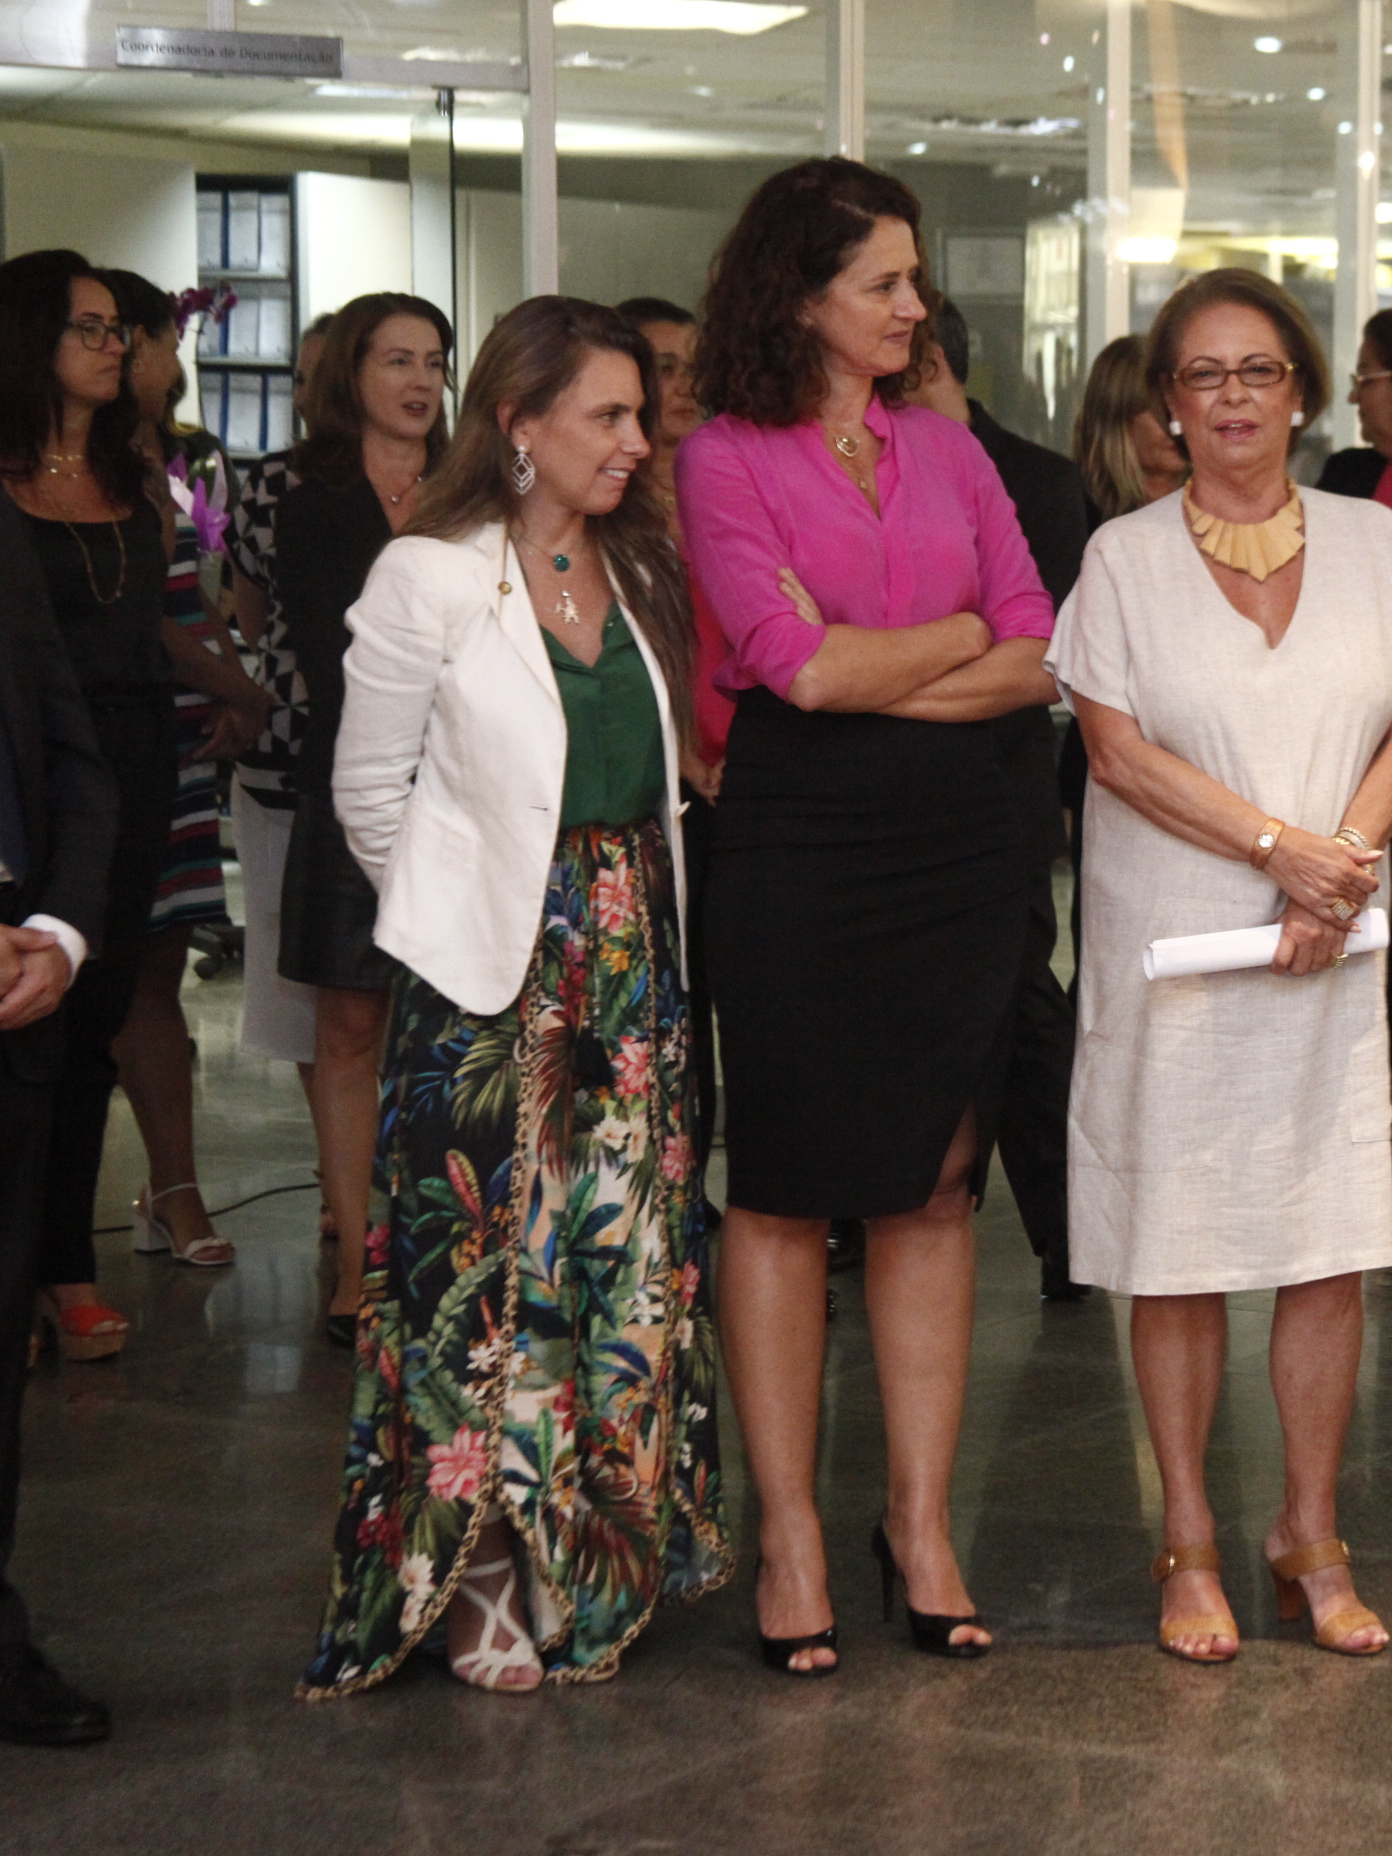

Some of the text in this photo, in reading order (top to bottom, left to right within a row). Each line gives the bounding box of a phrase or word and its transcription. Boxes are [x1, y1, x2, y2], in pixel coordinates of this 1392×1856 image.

[121, 40, 334, 65] Coordenadoria de Documentação
